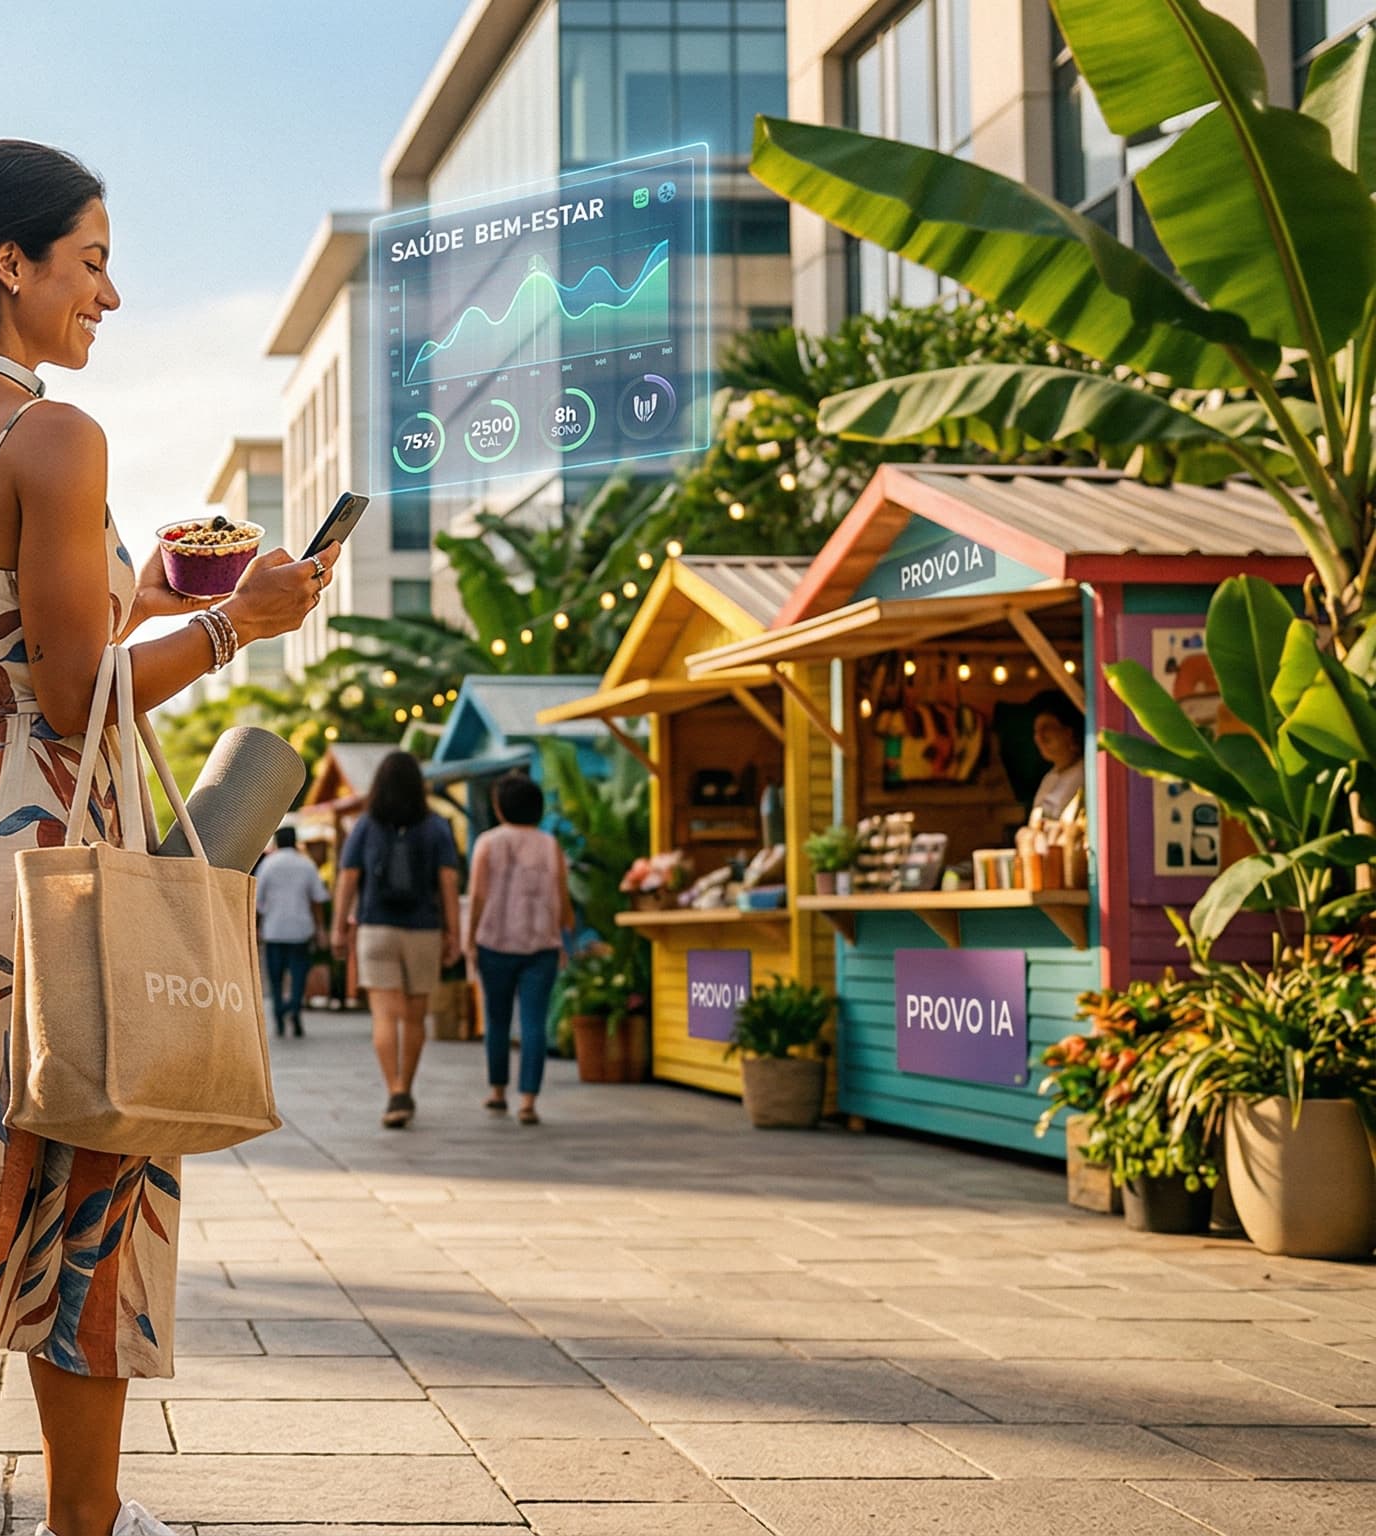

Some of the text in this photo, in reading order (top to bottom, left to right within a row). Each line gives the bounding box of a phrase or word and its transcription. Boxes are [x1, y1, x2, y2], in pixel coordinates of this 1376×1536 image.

[390, 198, 605, 263] SAÚDE BEM-ESTAR
[471, 416, 513, 438] 2500
[554, 406, 577, 424] 8h
[402, 432, 436, 451] 75%
[550, 423, 582, 438] SONO
[479, 438, 502, 449] CAL
[900, 543, 984, 591] PROVO IA
[144, 971, 244, 1013] PROVO
[691, 981, 732, 1009] PROVO
[906, 994, 1014, 1037] PROVO IA
